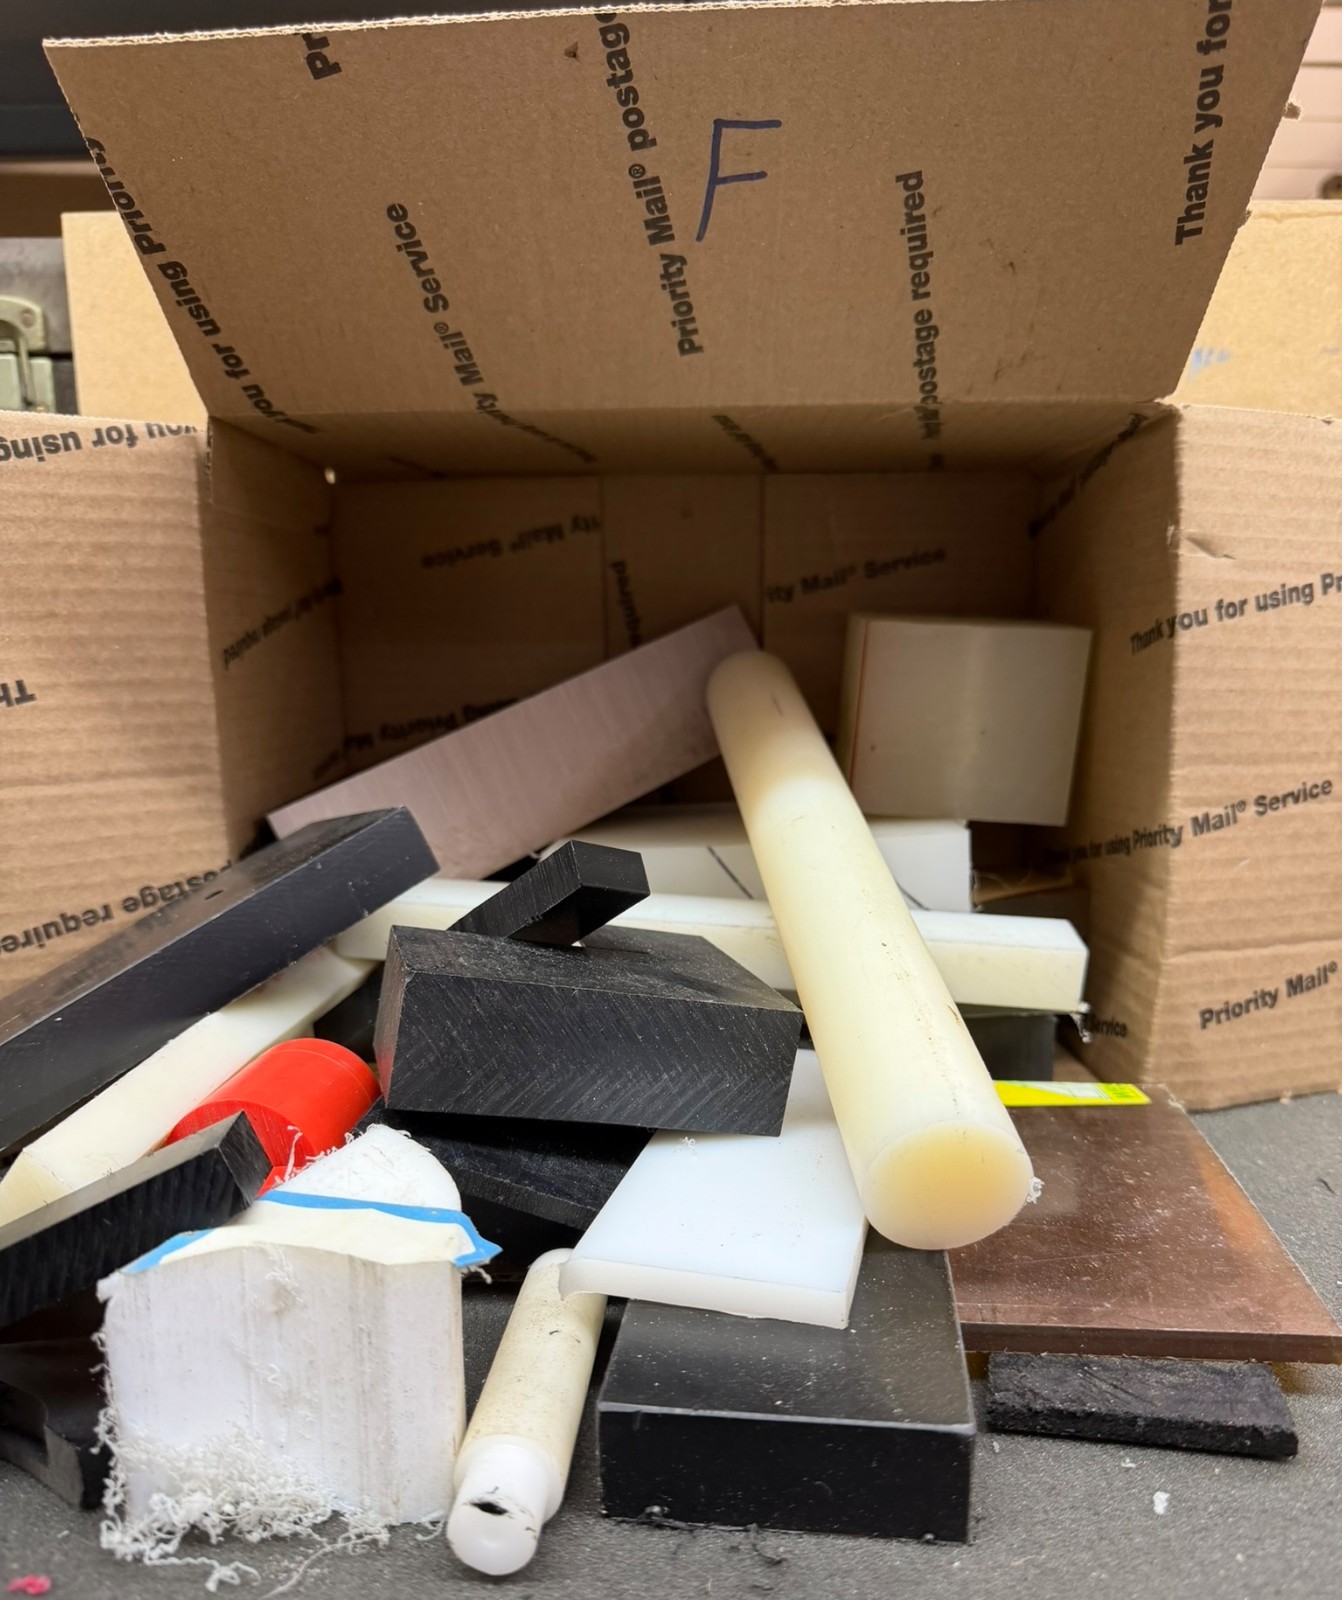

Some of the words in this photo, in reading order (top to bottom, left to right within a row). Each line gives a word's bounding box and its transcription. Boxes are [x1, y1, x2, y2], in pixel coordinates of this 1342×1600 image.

[695, 118, 783, 243] F
[1174, 138, 1214, 245] Thank
[1194, 64, 1224, 134] you
[628, 163, 675, 246] Mail®
[895, 170, 935, 301] required
[386, 203, 450, 314] Service
[157, 261, 221, 337] using
[658, 253, 704, 357] Priority
[211, 343, 251, 380] for
[433, 322, 484, 386] Mail®
[912, 308, 942, 405] postage
[92, 423, 139, 449] for
[863, 548, 947, 580] Service
[1130, 617, 1164, 656] Thank
[1166, 608, 1209, 639] you
[1215, 598, 1249, 622] for
[1255, 583, 1315, 606] using
[1132, 824, 1184, 849] Priority
[1190, 800, 1247, 837] Mail®
[1252, 779, 1333, 818] Service
[1199, 985, 1279, 1030] Priority
[1285, 960, 1339, 999] Mail®
